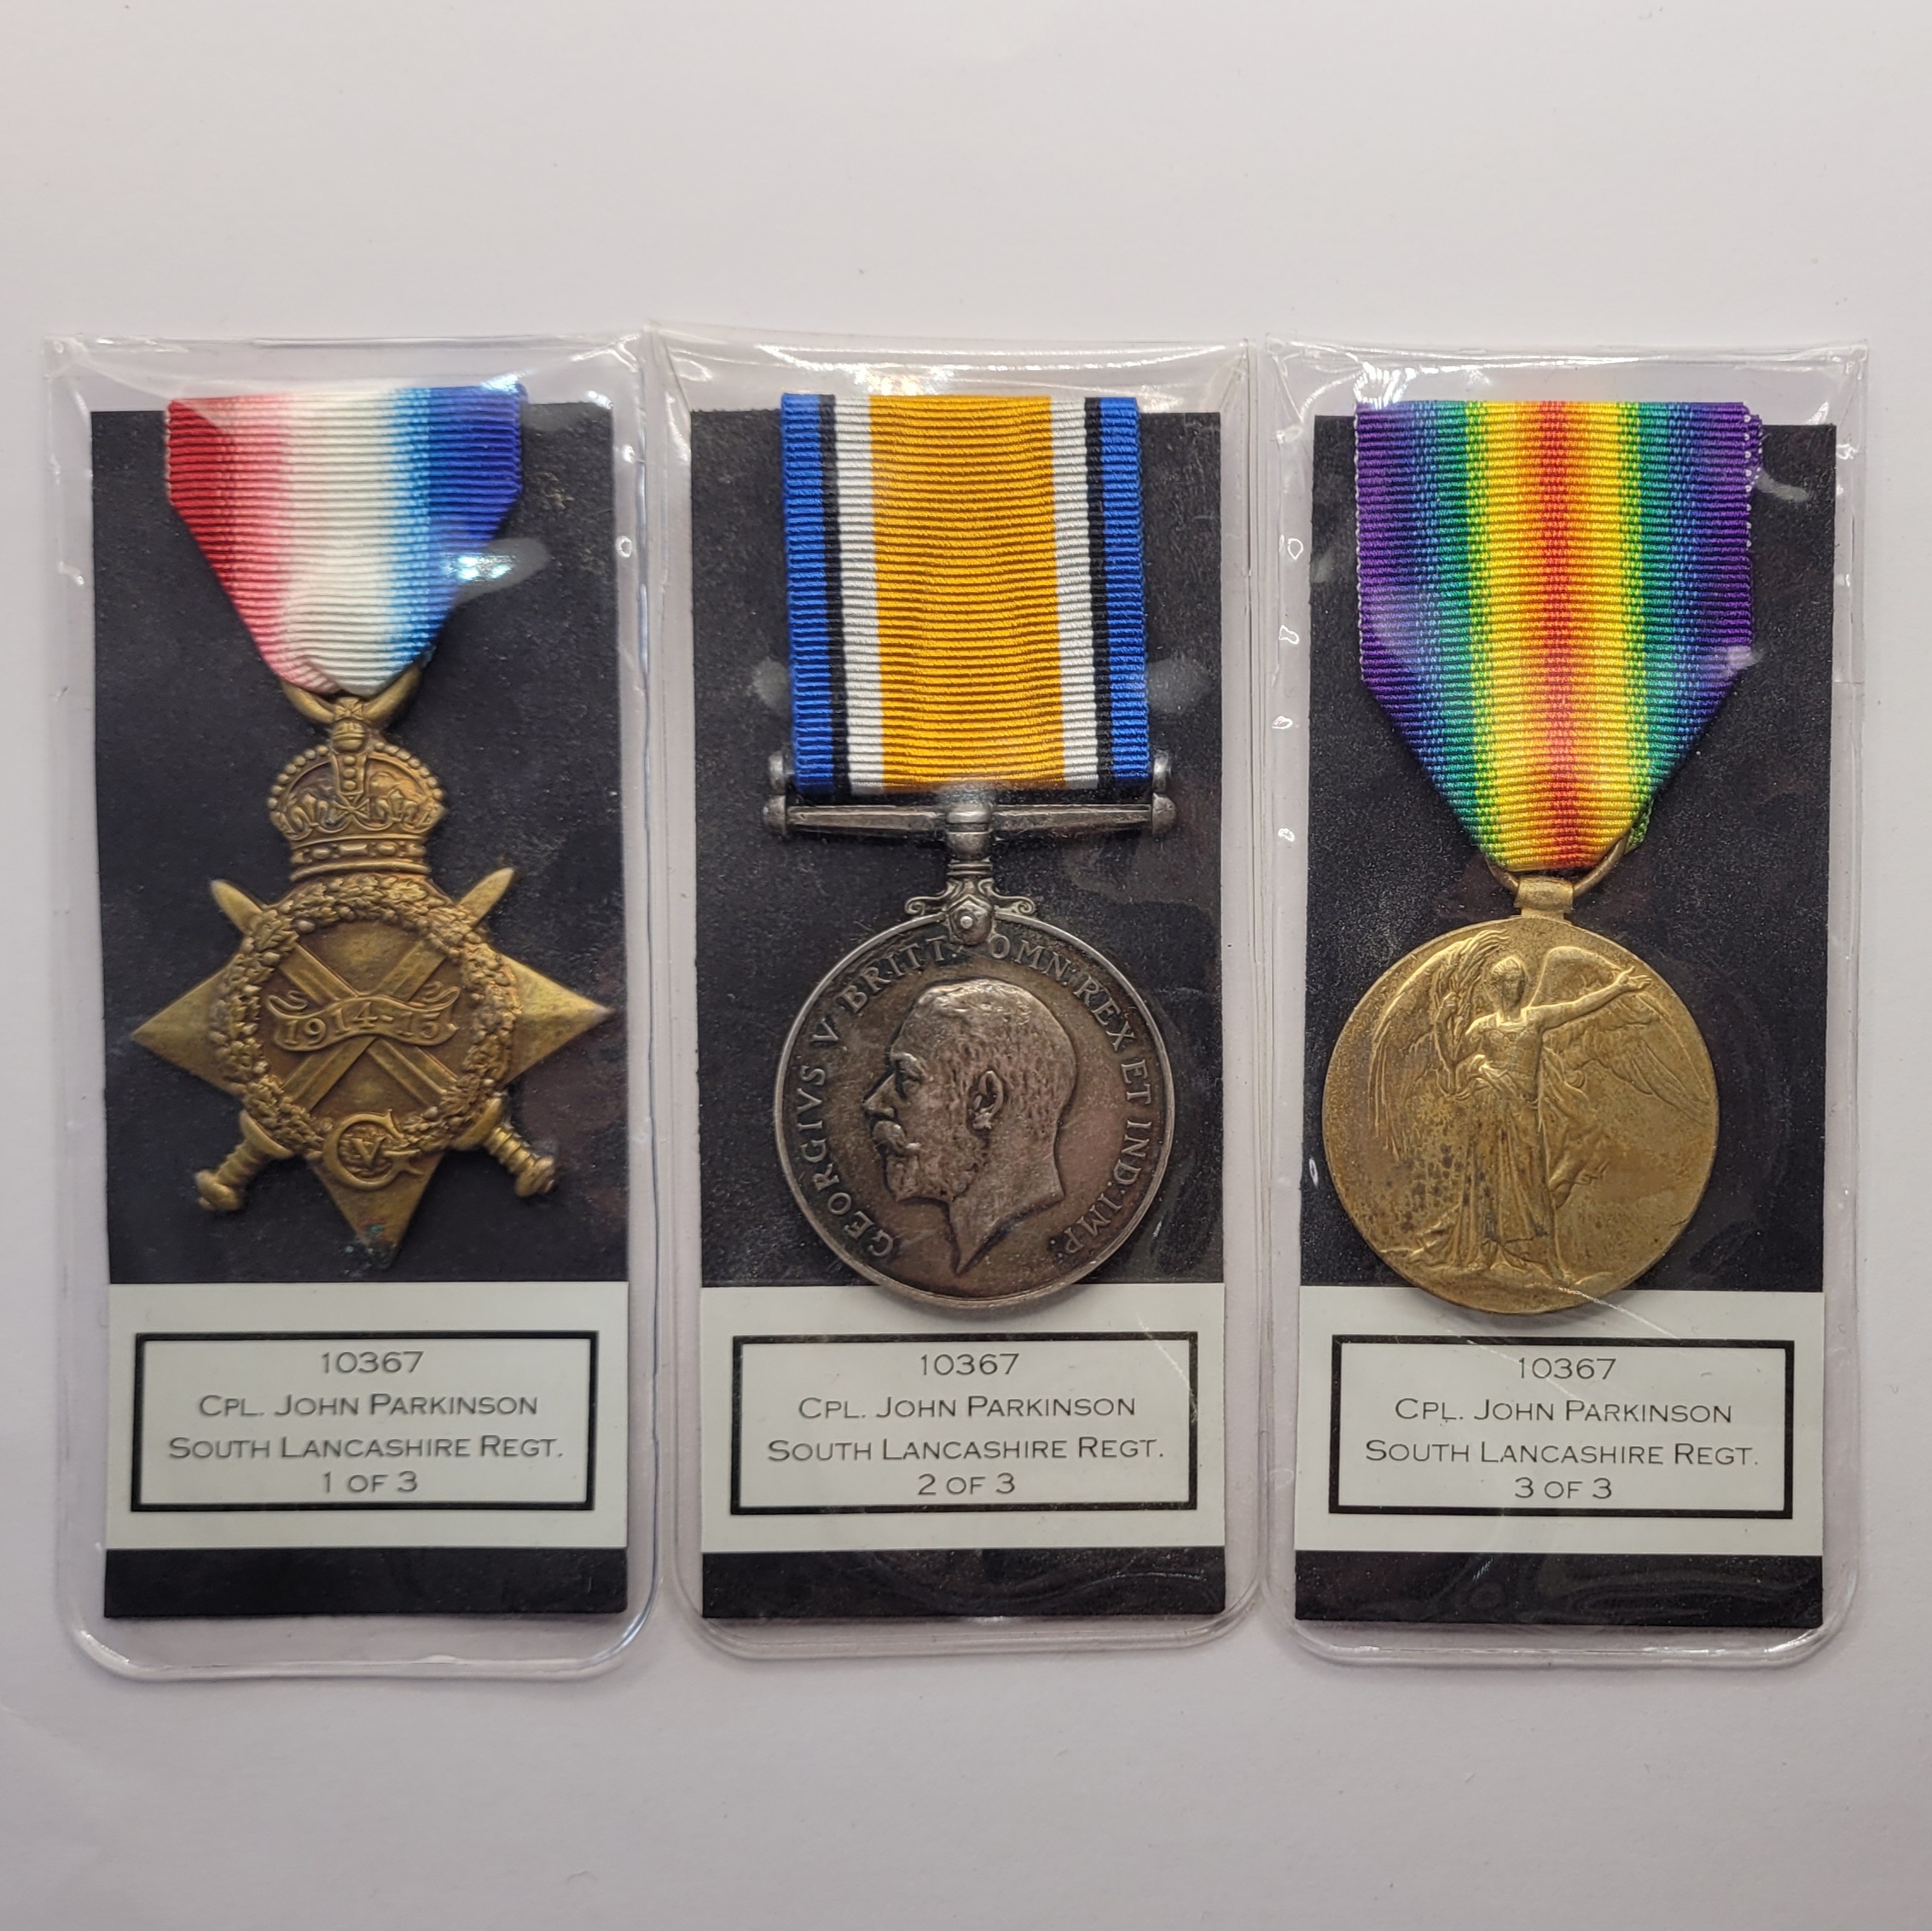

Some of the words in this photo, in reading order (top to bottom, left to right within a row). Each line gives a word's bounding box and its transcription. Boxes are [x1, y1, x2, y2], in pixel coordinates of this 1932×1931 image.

[284, 1001, 440, 1043] 1914-15
[813, 1013, 839, 1046] V
[1072, 975, 1136, 1052] REX
[1121, 1058, 1152, 1104] ET
[321, 1351, 424, 1374] 10367
[920, 1354, 1019, 1376] 10367
[1518, 1358, 1616, 1380] 10367
[199, 1395, 263, 1417] CPL.
[275, 1395, 358, 1416] JOHN
[370, 1394, 537, 1415] PARKINSON
[798, 1397, 866, 1419] CPL.
[876, 1396, 956, 1418] JOHN
[967, 1395, 1135, 1418] PARKINSON
[1395, 1398, 1463, 1421] CPL.
[1474, 1400, 1554, 1421] JOHN
[1565, 1400, 1732, 1424] PARKINSON
[170, 1436, 270, 1459] SOUTH
[281, 1435, 470, 1458] LANCASHIRE
[480, 1435, 562, 1458] REGT.
[768, 1440, 872, 1462] SOUTH
[883, 1439, 1067, 1461] LANCASHIRE
[1078, 1436, 1163, 1458] REGT.
[1365, 1441, 1469, 1463] SOUTH
[1480, 1441, 1663, 1464] LANCASHIRE
[1674, 1443, 1757, 1465] REGT.
[322, 1472, 331, 1493] 1
[347, 1475, 387, 1493] OF
[397, 1471, 418, 1493] 3
[918, 1475, 937, 1496] 2
[947, 1476, 985, 1495] OF
[995, 1473, 1015, 1494] 3
[1514, 1476, 1534, 1499] 3
[1544, 1480, 1582, 1499] OF
[1593, 1478, 1612, 1499] 3
